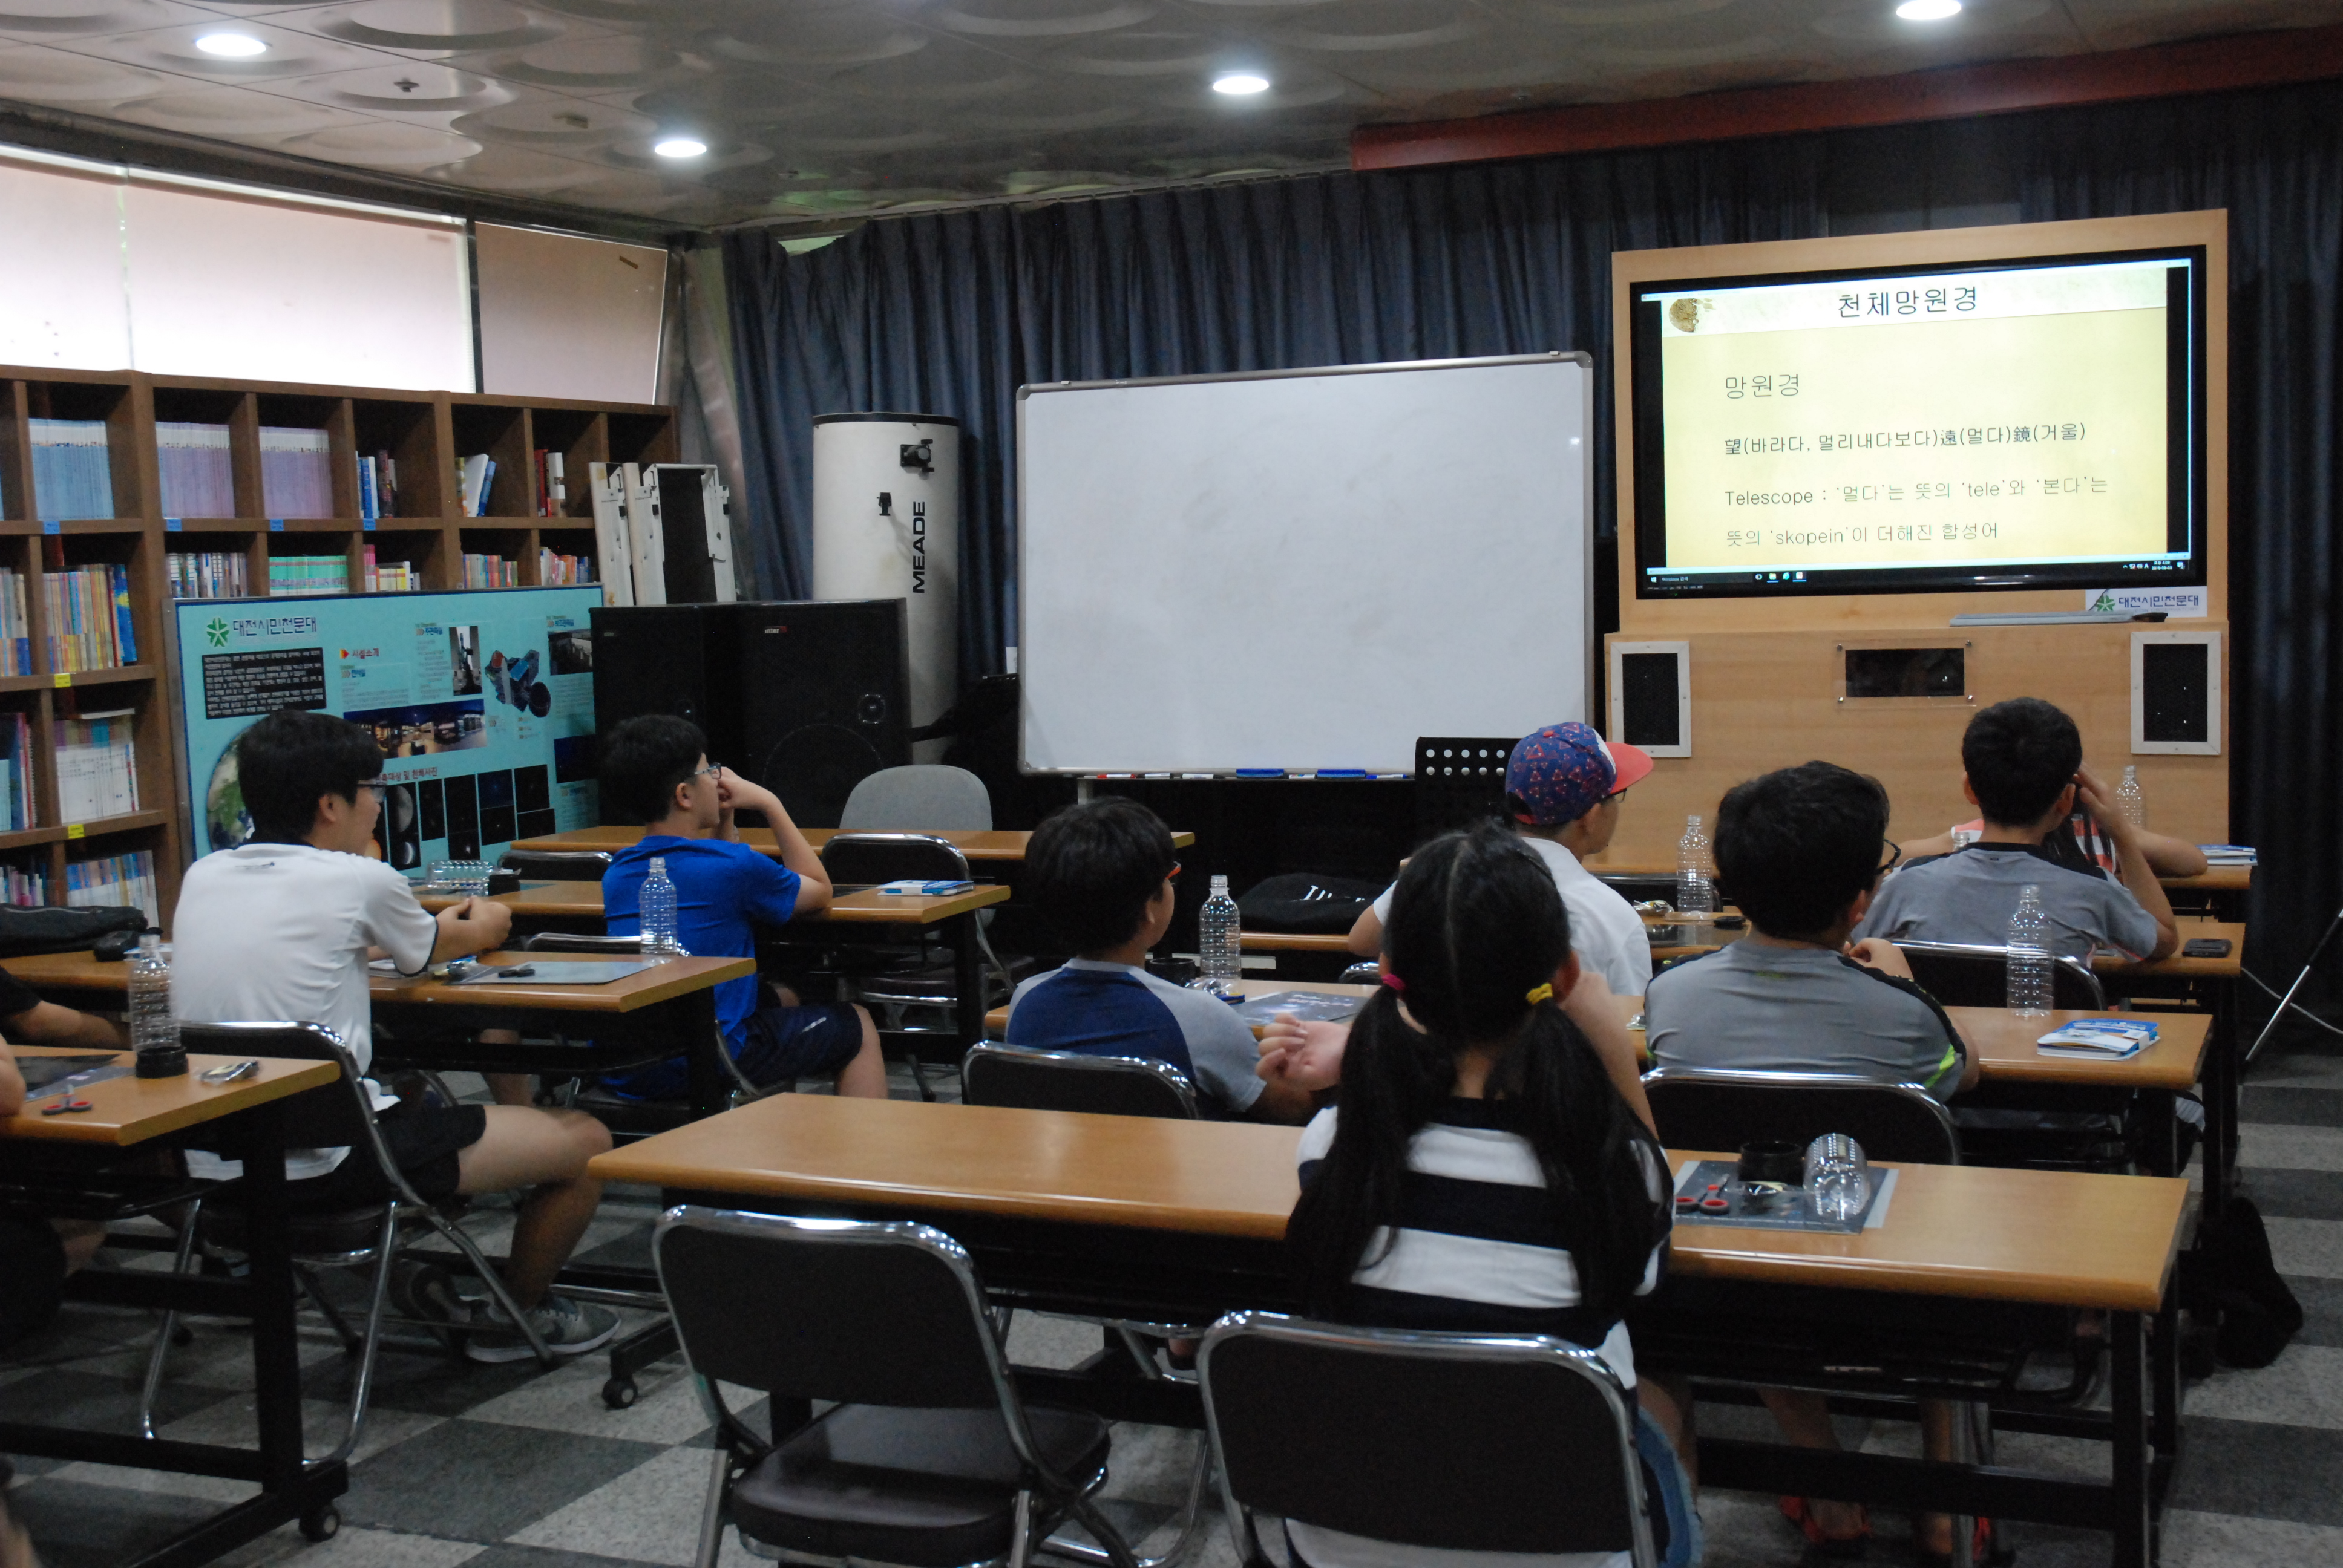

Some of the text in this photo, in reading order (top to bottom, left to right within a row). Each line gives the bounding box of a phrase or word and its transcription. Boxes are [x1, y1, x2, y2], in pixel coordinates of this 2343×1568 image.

[1838, 286, 1976, 318] 천체망원경
[1726, 373, 1798, 399] 망원경
[1725, 490, 1814, 506] Telescope
[1915, 482, 1950, 500] 뜻의
[913, 501, 925, 593] MEADE
[1726, 530, 1760, 547] 뜻의
[1878, 524, 1932, 542] 더해진
[1942, 522, 1997, 540] 합성어
[2119, 595, 2199, 608] 대전시민천문대
[232, 616, 317, 636] 대전시민천문대
